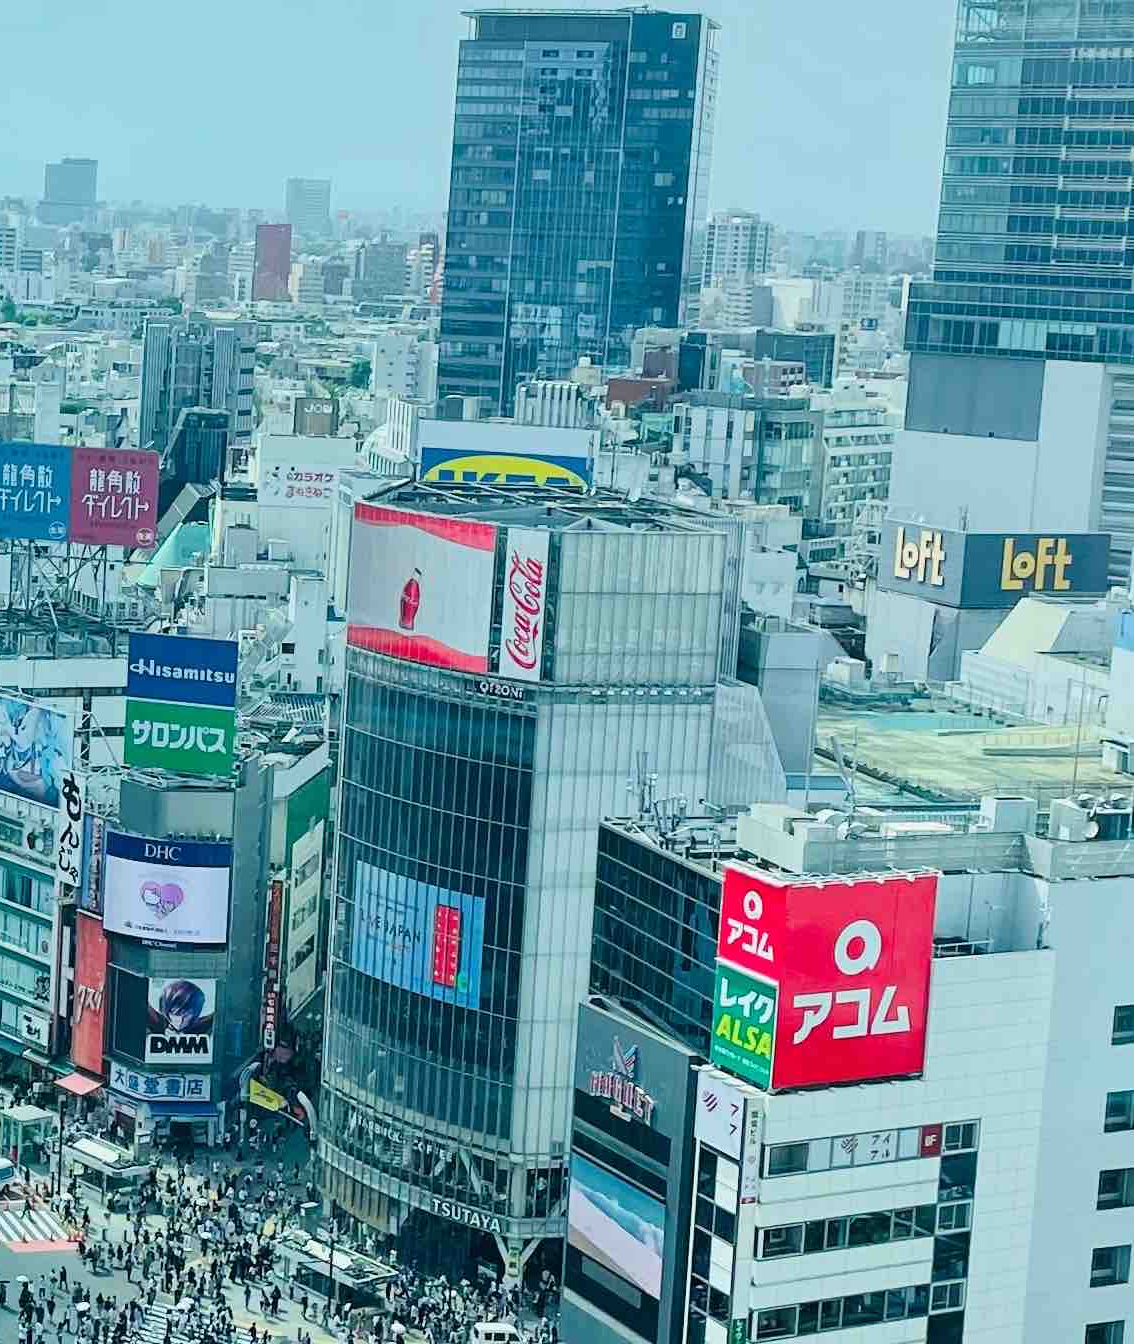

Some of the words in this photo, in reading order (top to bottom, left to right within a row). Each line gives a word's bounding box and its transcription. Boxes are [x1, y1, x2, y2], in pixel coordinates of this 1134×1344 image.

[3, 463, 53, 488] 龍角散
[90, 468, 141, 494] 龍角散
[130, 659, 235, 683] Hisamitsu
[132, 719, 227, 754] サロンパス
[145, 843, 182, 862] DHC
[727, 918, 775, 962] アコム
[721, 977, 774, 1024] レイク
[793, 985, 912, 1045] アコム
[150, 1035, 209, 1054] DMM
[716, 1014, 772, 1058] ALSA
[432, 1198, 502, 1233] TSUTAYA
